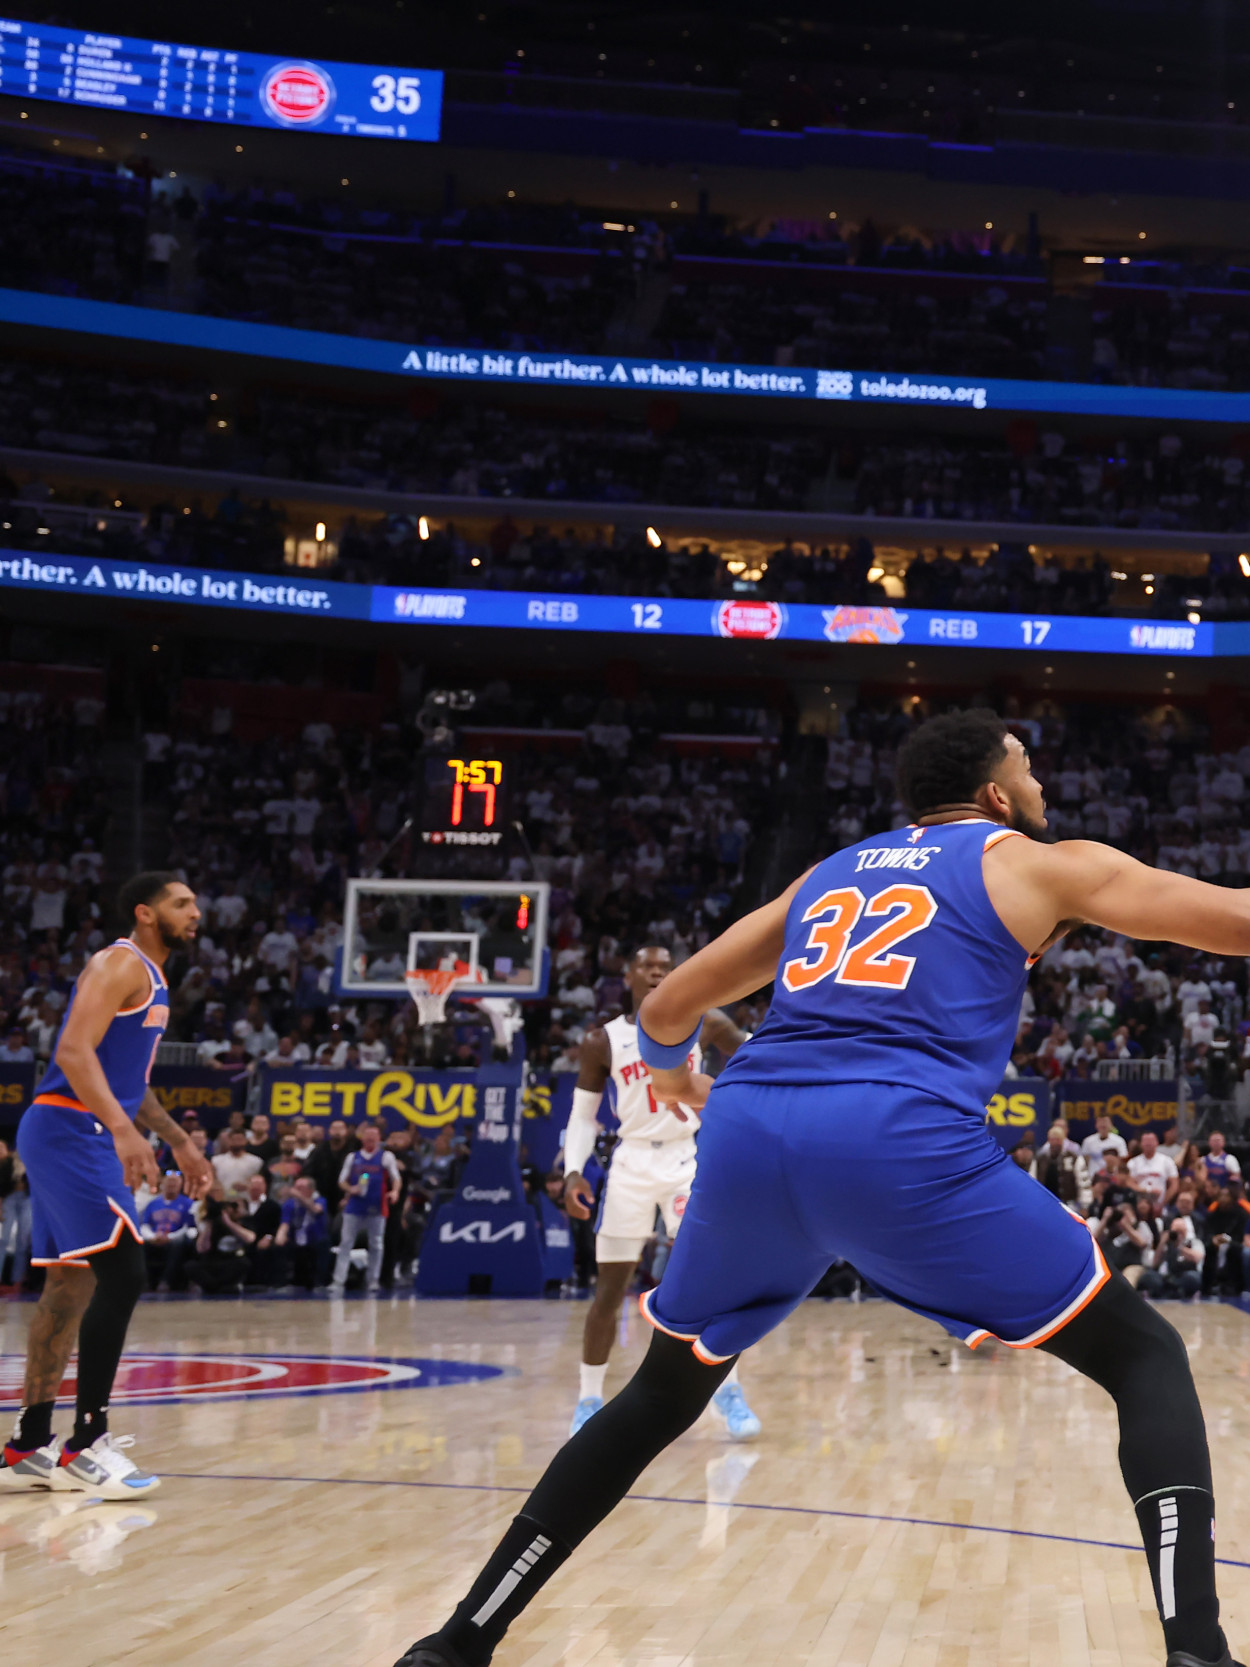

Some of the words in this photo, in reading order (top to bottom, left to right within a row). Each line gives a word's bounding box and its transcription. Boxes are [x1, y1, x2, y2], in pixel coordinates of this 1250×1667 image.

[370, 74, 421, 115] 35
[403, 351, 422, 370] A
[426, 351, 479, 373] little
[482, 355, 513, 375] bit
[517, 356, 605, 381] further.
[609, 363, 628, 383] A
[632, 364, 698, 386] whole
[701, 367, 730, 387] lot
[734, 369, 805, 392] better.
[860, 377, 987, 409] toledozoo.org
[83, 565, 106, 588] A
[113, 568, 197, 596] whole
[202, 575, 237, 600] lot
[242, 579, 331, 609] better.
[527, 600, 578, 622] REB
[631, 603, 663, 629] 12
[929, 618, 978, 639] REB
[1020, 620, 1052, 645] 17
[447, 759, 503, 785] 7:57
[451, 783, 496, 826] 17
[444, 831, 503, 845] TISSOT
[855, 846, 942, 873] TOWNS
[782, 883, 939, 993] 32
